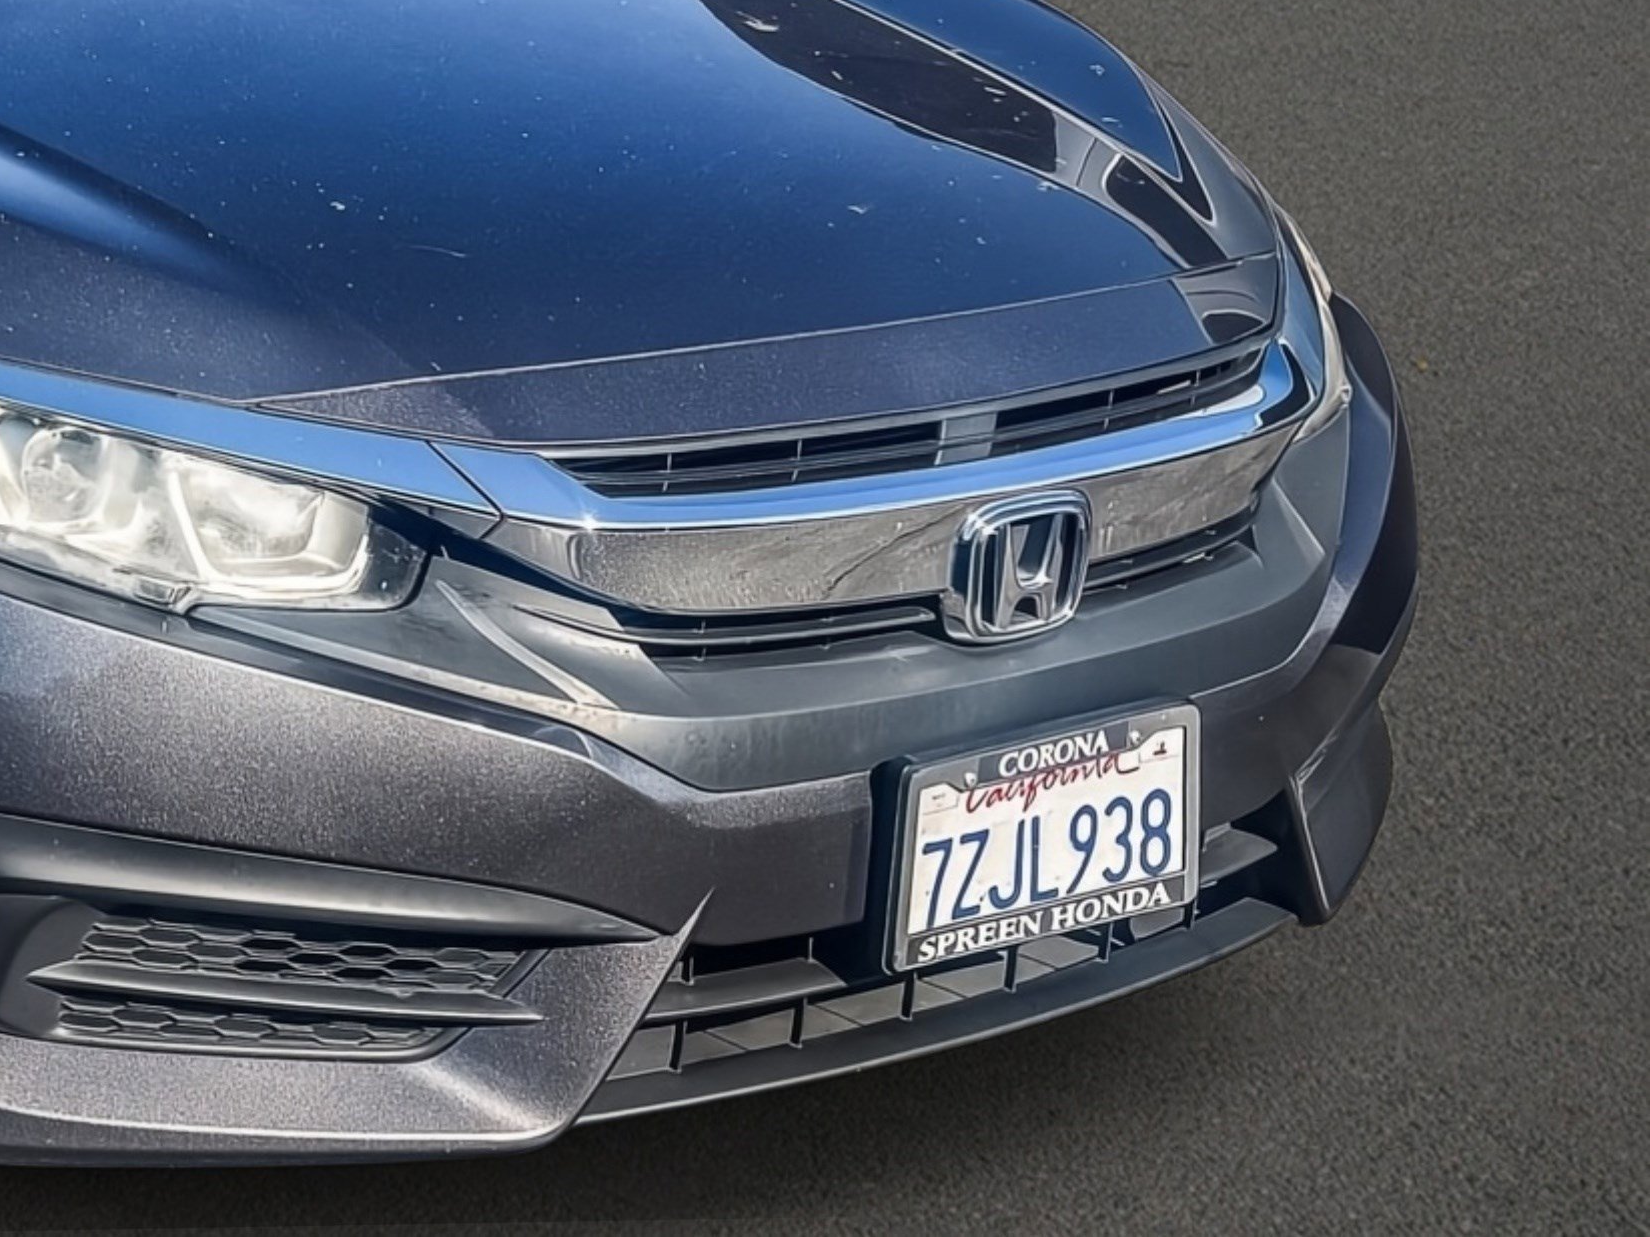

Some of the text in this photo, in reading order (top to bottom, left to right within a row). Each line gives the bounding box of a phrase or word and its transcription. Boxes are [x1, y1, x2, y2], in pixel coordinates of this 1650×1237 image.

[998, 728, 1110, 777] CORONA
[921, 788, 1172, 930] 7ZJL938
[916, 881, 1172, 963] SPREEN HONDA
